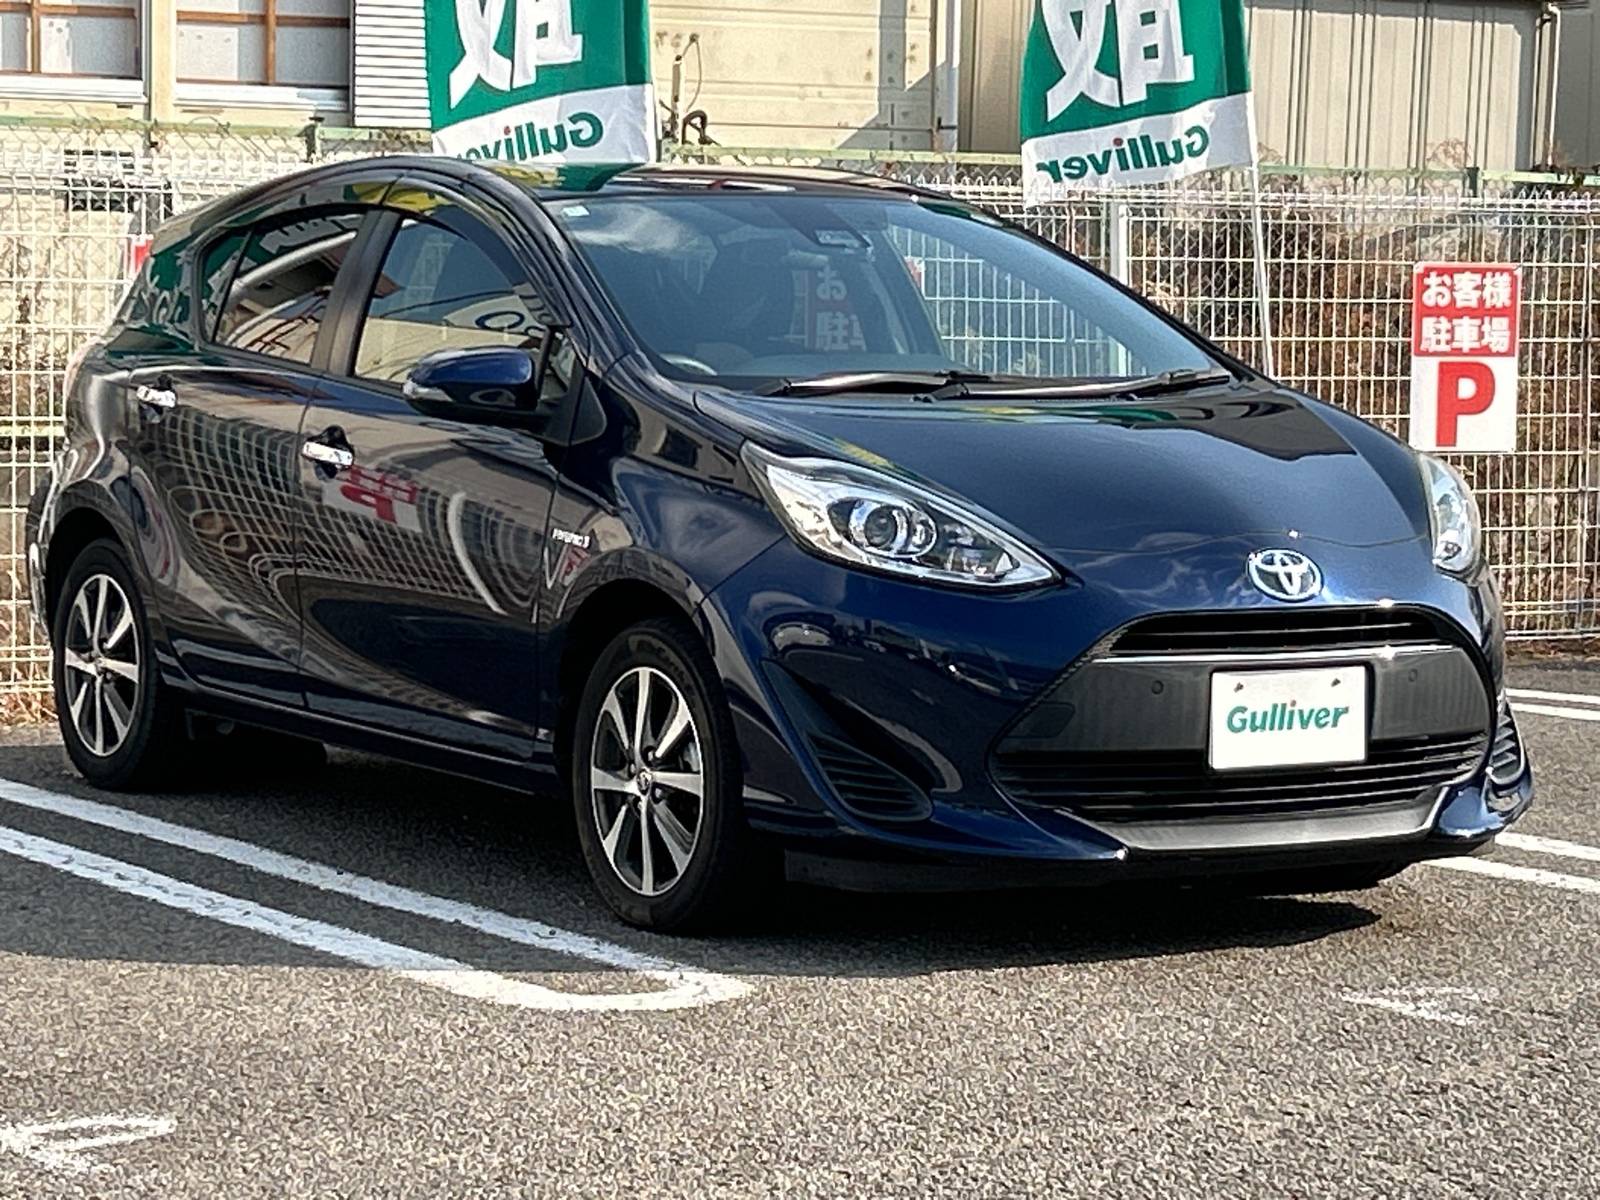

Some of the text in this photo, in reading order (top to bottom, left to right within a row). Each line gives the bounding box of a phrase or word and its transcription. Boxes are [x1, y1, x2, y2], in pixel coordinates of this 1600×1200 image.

[1422, 271, 1512, 309] お客様
[1419, 315, 1510, 352] 駐車場
[1436, 361, 1495, 446] P
[1227, 700, 1349, 733] Gulliver
